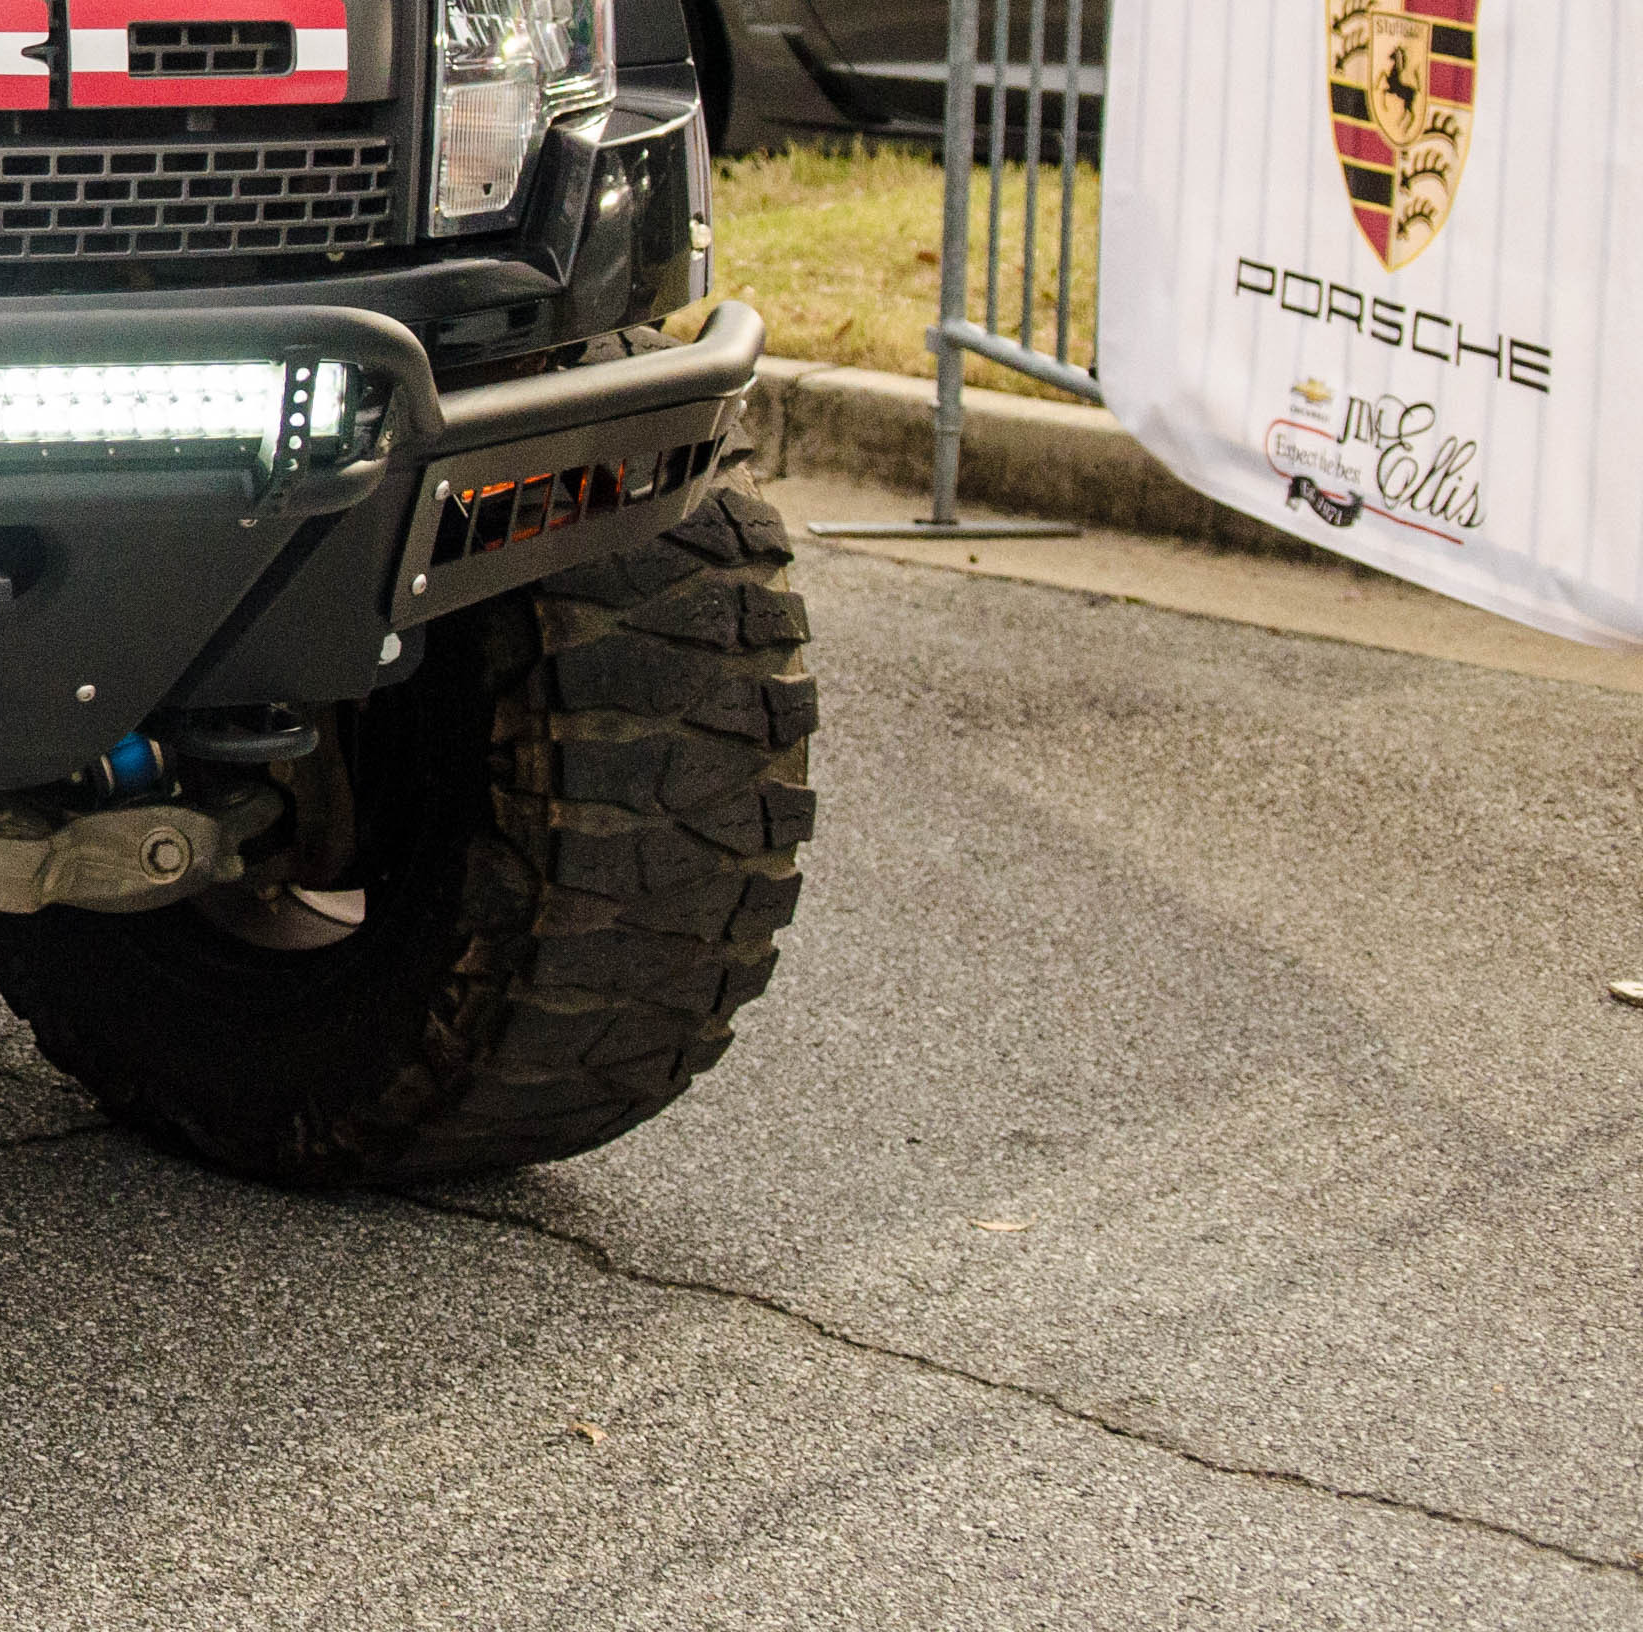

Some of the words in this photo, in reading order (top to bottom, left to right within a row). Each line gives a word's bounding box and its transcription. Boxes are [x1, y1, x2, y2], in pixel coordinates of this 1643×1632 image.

[1235, 255, 1553, 394] PORSCHE
[1336, 396, 1384, 450] JIM
[1375, 394, 1487, 529] Ellis
